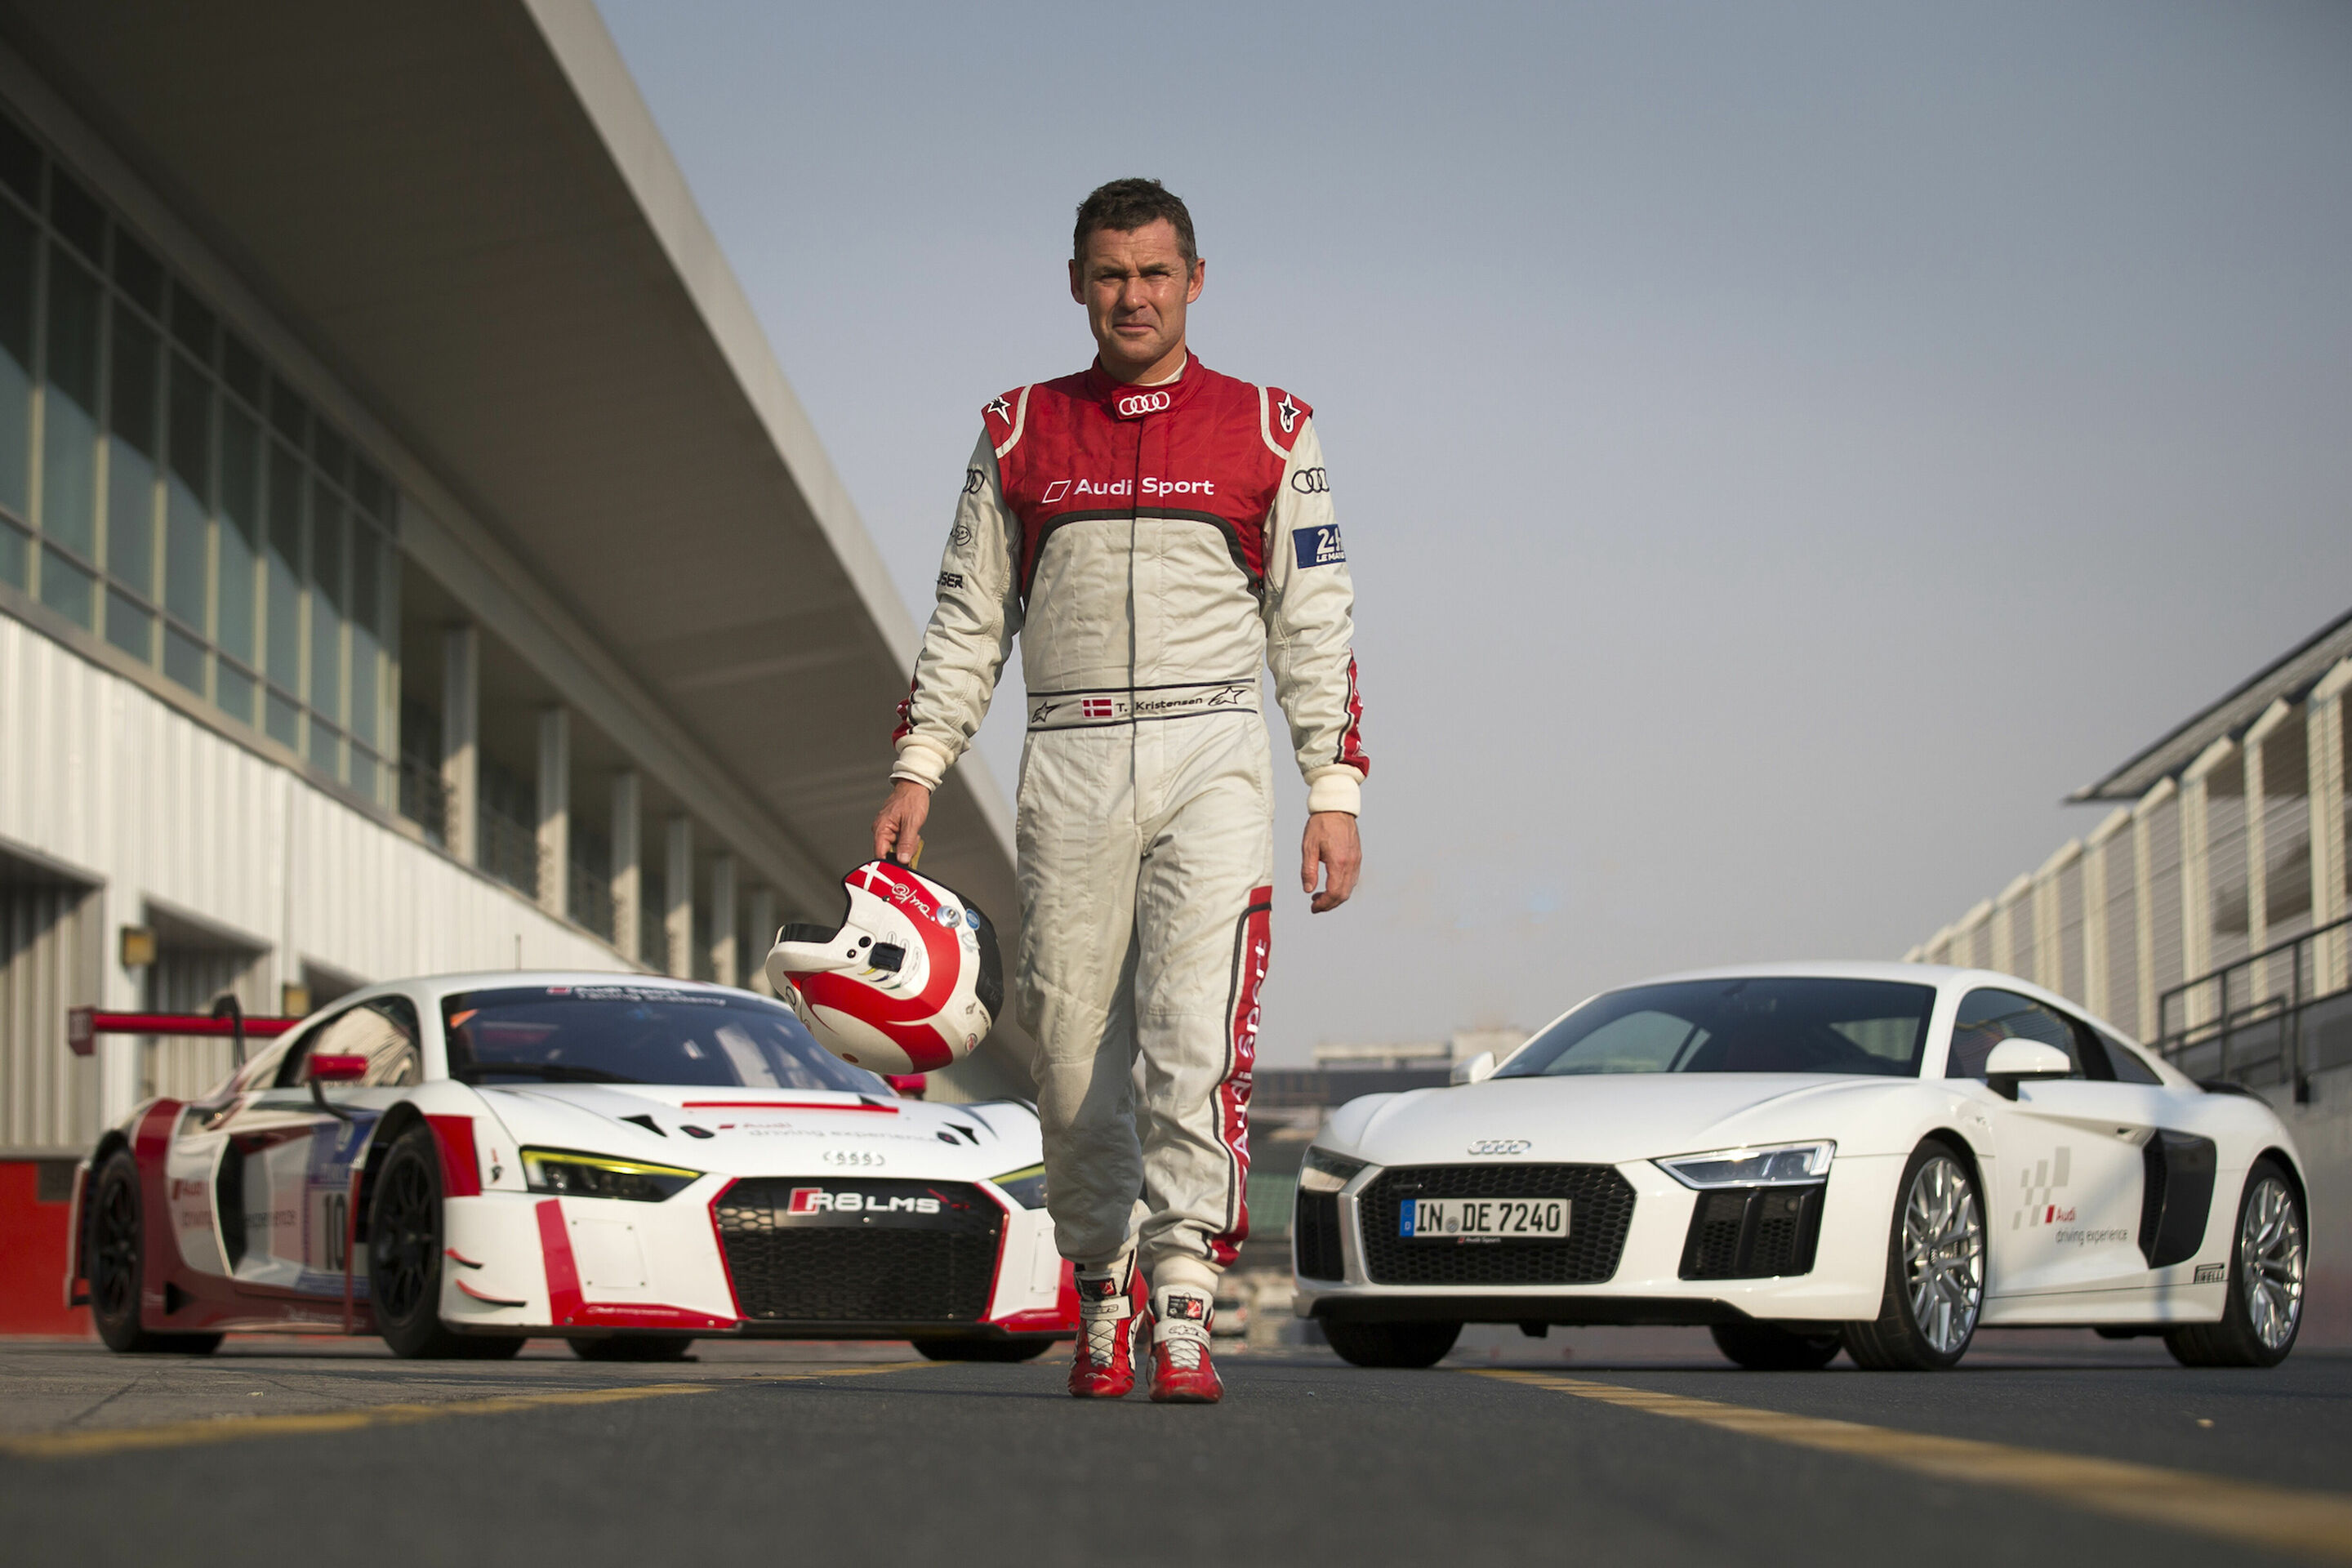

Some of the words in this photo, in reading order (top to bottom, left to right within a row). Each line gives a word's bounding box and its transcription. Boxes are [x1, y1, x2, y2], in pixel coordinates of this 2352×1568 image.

[1073, 479, 1132, 496] Audi
[1142, 477, 1215, 497] Sport
[1316, 554, 1328, 563] LE
[937, 571, 963, 589] SER
[1116, 702, 1128, 712] T.
[1136, 697, 1203, 710] Kristensen
[806, 1192, 862, 1211] R8
[865, 1196, 940, 1214] LMS
[1416, 1203, 1444, 1232] IN
[1461, 1203, 1492, 1232] DE
[1499, 1202, 1561, 1232] 7240
[2056, 1206, 2077, 1222] Audi
